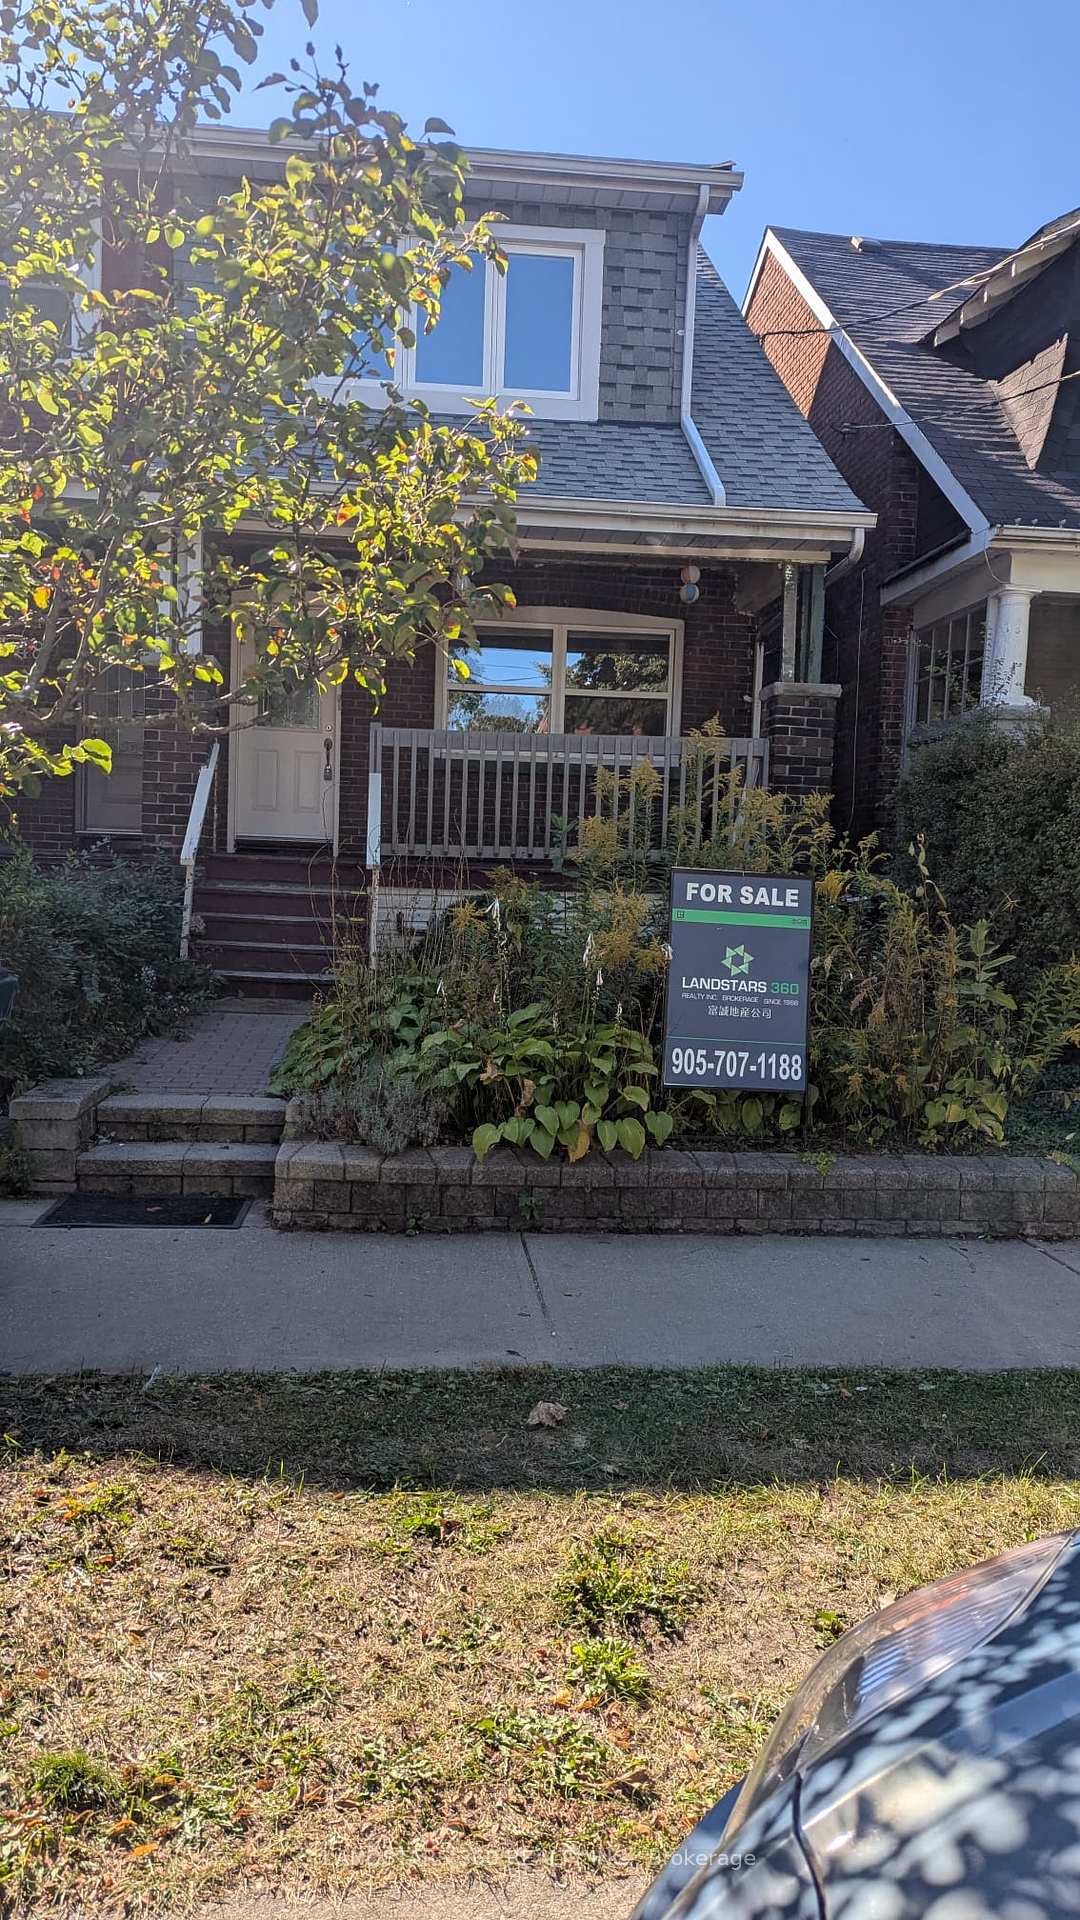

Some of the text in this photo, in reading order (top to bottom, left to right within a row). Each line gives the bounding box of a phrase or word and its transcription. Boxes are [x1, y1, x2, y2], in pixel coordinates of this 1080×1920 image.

[686, 882, 799, 908] FOR SALE
[682, 976, 800, 995] LANDSTARS 360
[681, 992, 705, 1000] REALTY
[721, 994, 760, 1003] BROKERAGE
[671, 1047, 802, 1080] 905-707-1188
